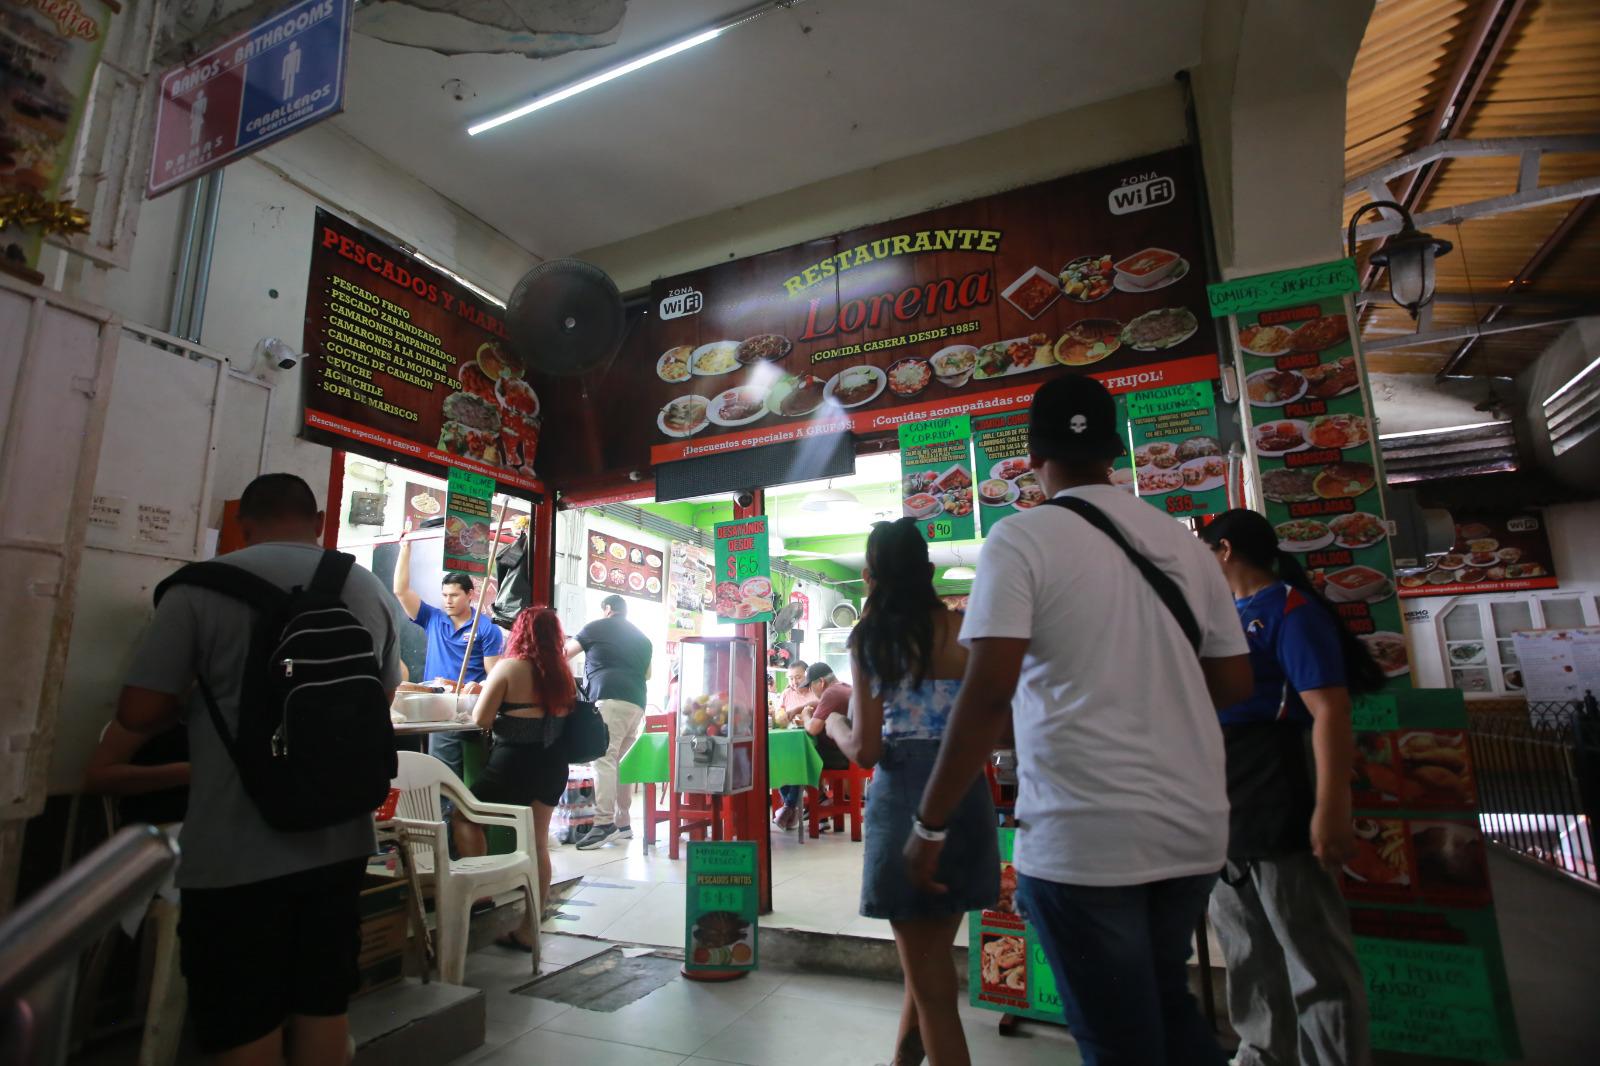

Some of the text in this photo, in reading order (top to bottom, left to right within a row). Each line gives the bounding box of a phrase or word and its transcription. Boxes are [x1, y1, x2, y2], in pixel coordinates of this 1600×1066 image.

[171, 58, 221, 97] BAÑOS
[234, 0, 334, 64] BATHROOMS
[245, 83, 331, 133] CABALLEROS
[1111, 179, 1172, 212] WiFi
[1120, 171, 1159, 187] ZONA
[321, 227, 439, 302] PESCADOS
[441, 290, 456, 312] Y
[783, 229, 1002, 298] RESTAURANTE
[332, 276, 410, 319] PESCADO FRITO
[661, 292, 701, 317] WiFi
[668, 286, 694, 297] ZONA
[800, 270, 994, 342] Lorena
[330, 302, 457, 364] CAMARONES EMPANIZADOS
[331, 289, 441, 346] PESCADO ZARANDEADO
[328, 329, 462, 390] CAMARONES AL MOJO DE AJO
[329, 315, 447, 372] CAMARONES A LA DIABLA
[811, 321, 980, 364] ¡COMIDA CASERA DESDE 1985!
[324, 368, 384, 397] AGUACHILE
[326, 342, 434, 390] COCTEL DE CAMARON
[326, 355, 372, 380] CEVICHE
[323, 381, 418, 422] SOPA DE MARISCOS
[872, 410, 928, 429] ¡Comidas
[929, 397, 1012, 419] acompañadas
[1107, 370, 1164, 390] FRIJOL!
[683, 440, 740, 457] ¡Descuentos
[741, 431, 794, 448] especiales
[796, 428, 804, 438] A
[717, 521, 765, 539] DESAYUNOS
[728, 538, 754, 552] DESDE
[927, 523, 951, 538] $90
[697, 874, 752, 885] PESCADOS FRITOS
